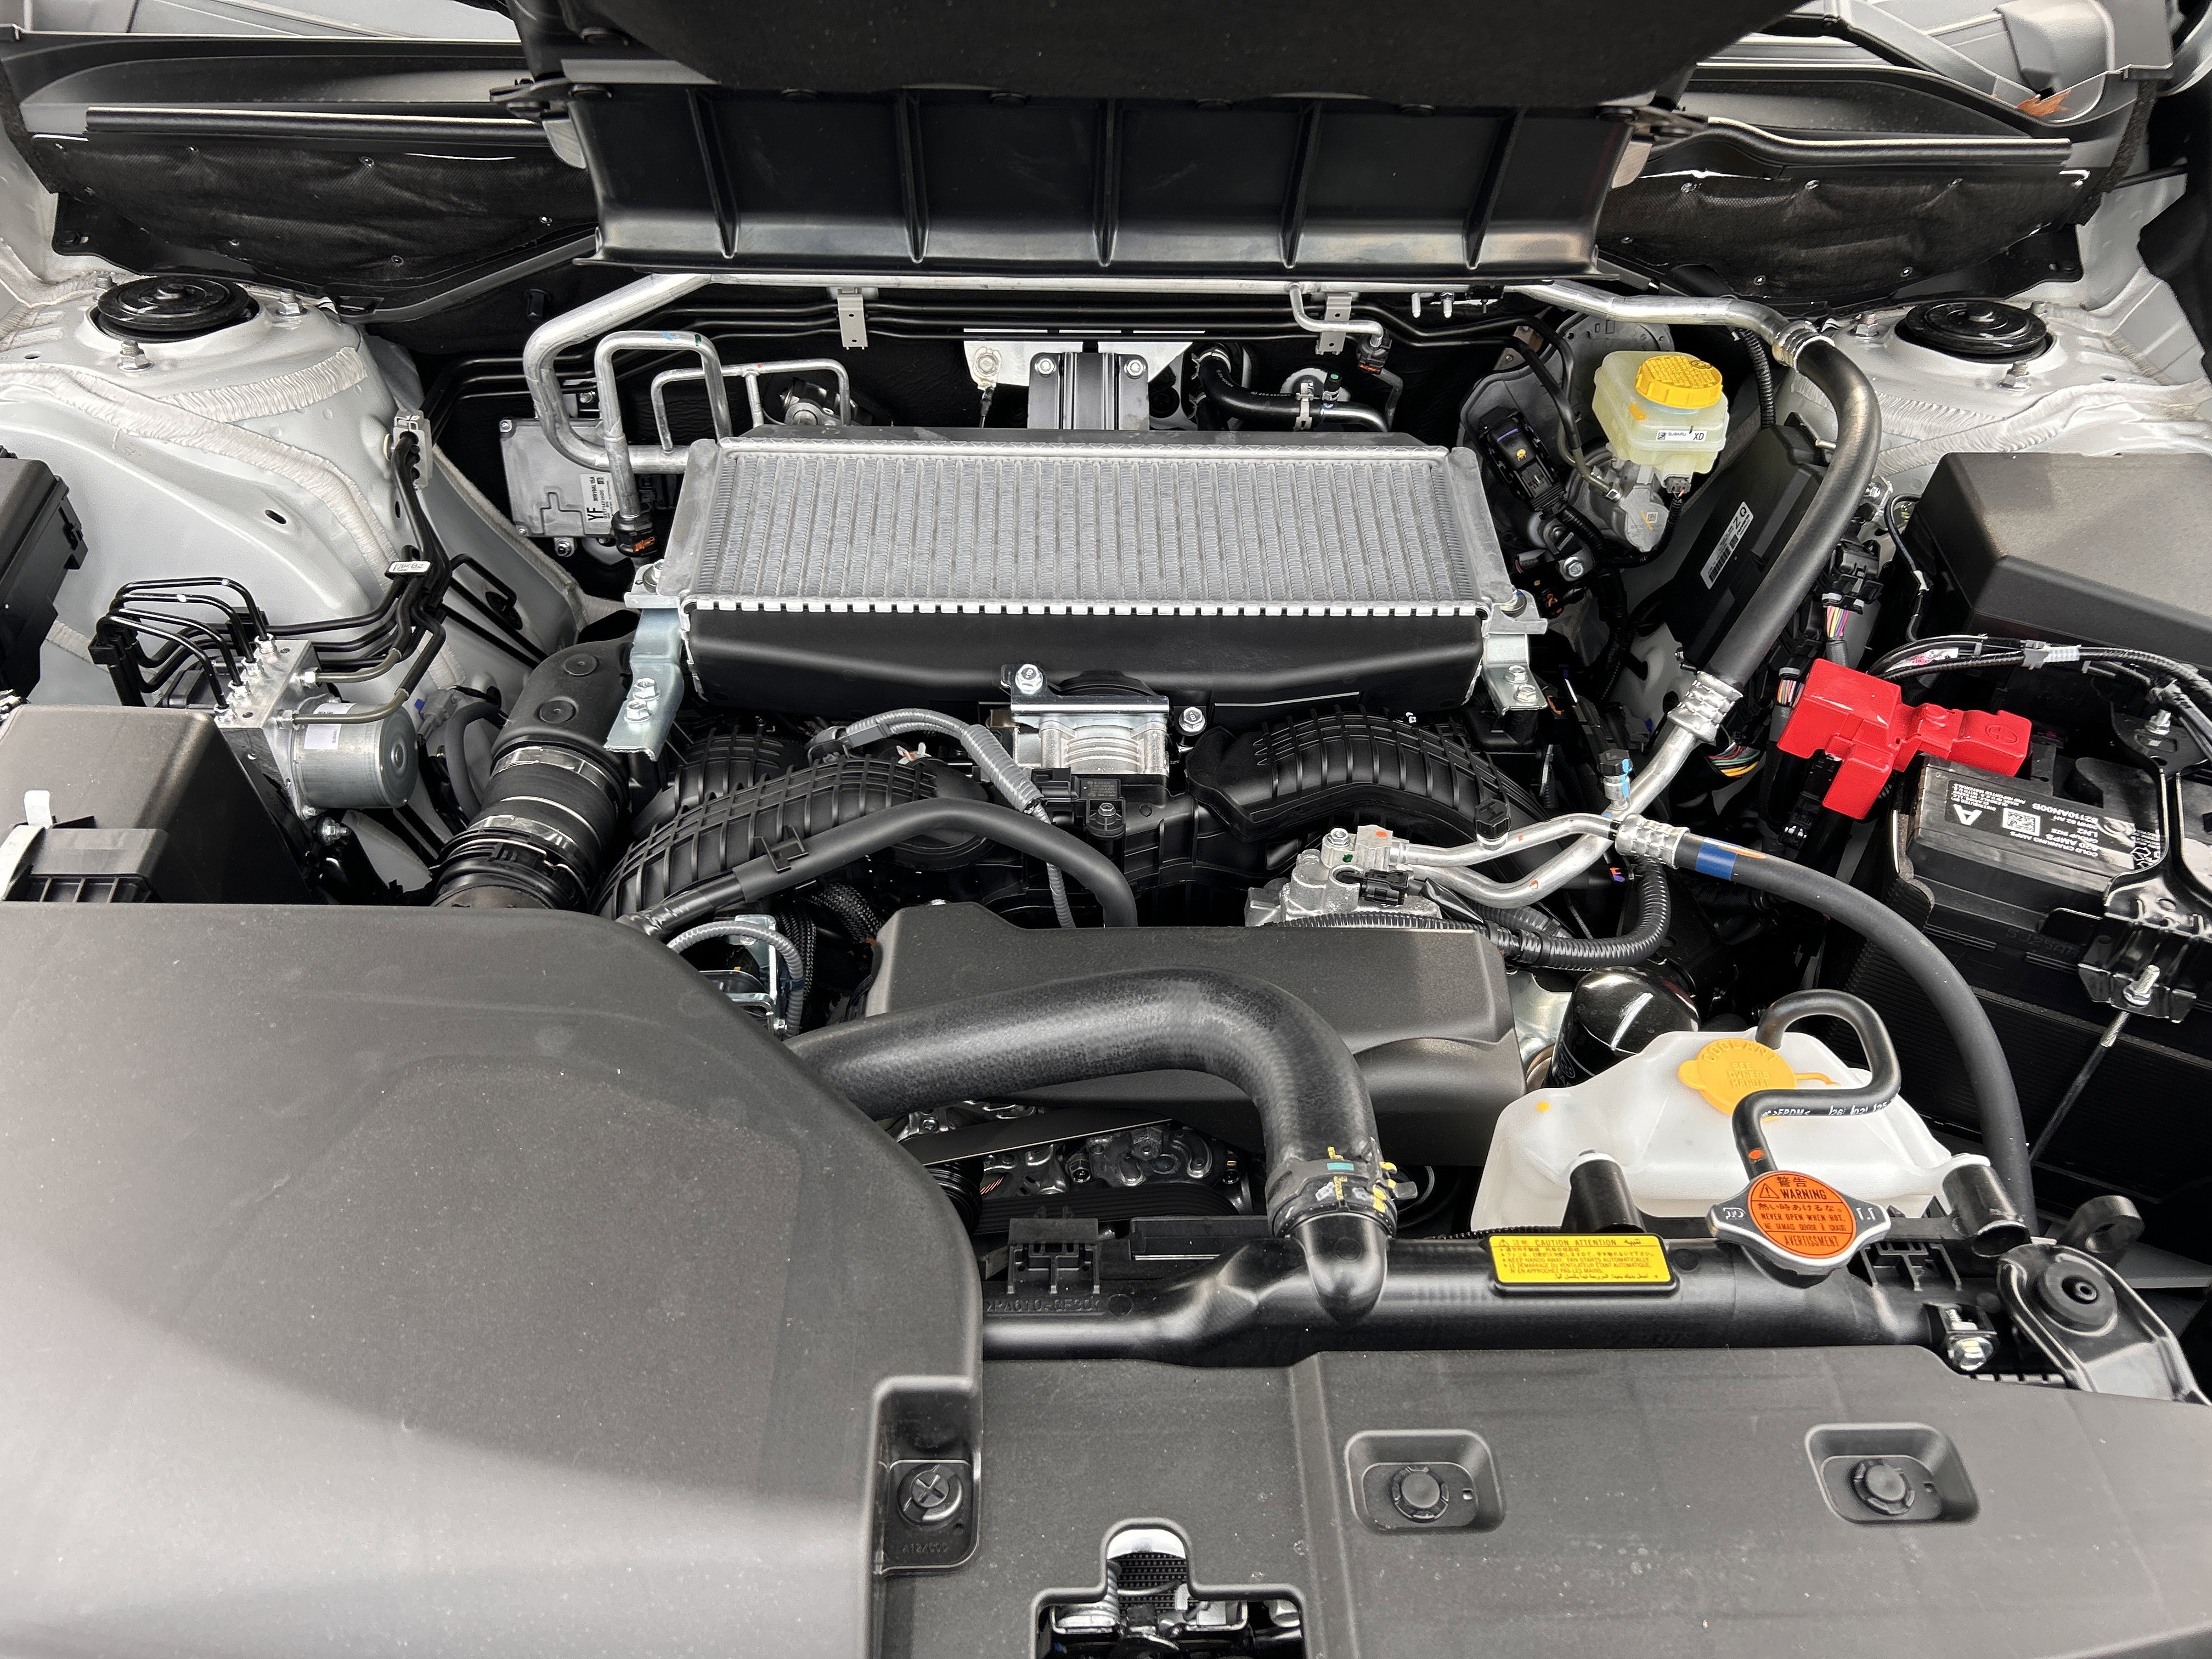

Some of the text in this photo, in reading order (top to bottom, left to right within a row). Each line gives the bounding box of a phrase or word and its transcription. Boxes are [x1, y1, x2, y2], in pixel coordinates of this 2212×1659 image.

[1693, 432, 1704, 441] XD
[586, 507, 603, 521] YF
[1961, 799, 1996, 811] DISTRIBUTED
[1953, 804, 1982, 825] A
[2069, 833, 2098, 843] GROUP
[2076, 828, 2098, 837] LN2
[2010, 831, 2098, 857] COLD CRANKING AMPS
[2045, 834, 2078, 845] AMPS
[1702, 1040, 1780, 1062] COOLANT
[1731, 1062, 1753, 1070] SEE
[1728, 1071, 1770, 1080] OWNERS
[1730, 1080, 1771, 1088] MANUAL
[1776, 1176, 1807, 1188] 警告
[1780, 1189, 1827, 1200] WARNING
[1784, 1235, 1840, 1247] AVERTISSMENT
